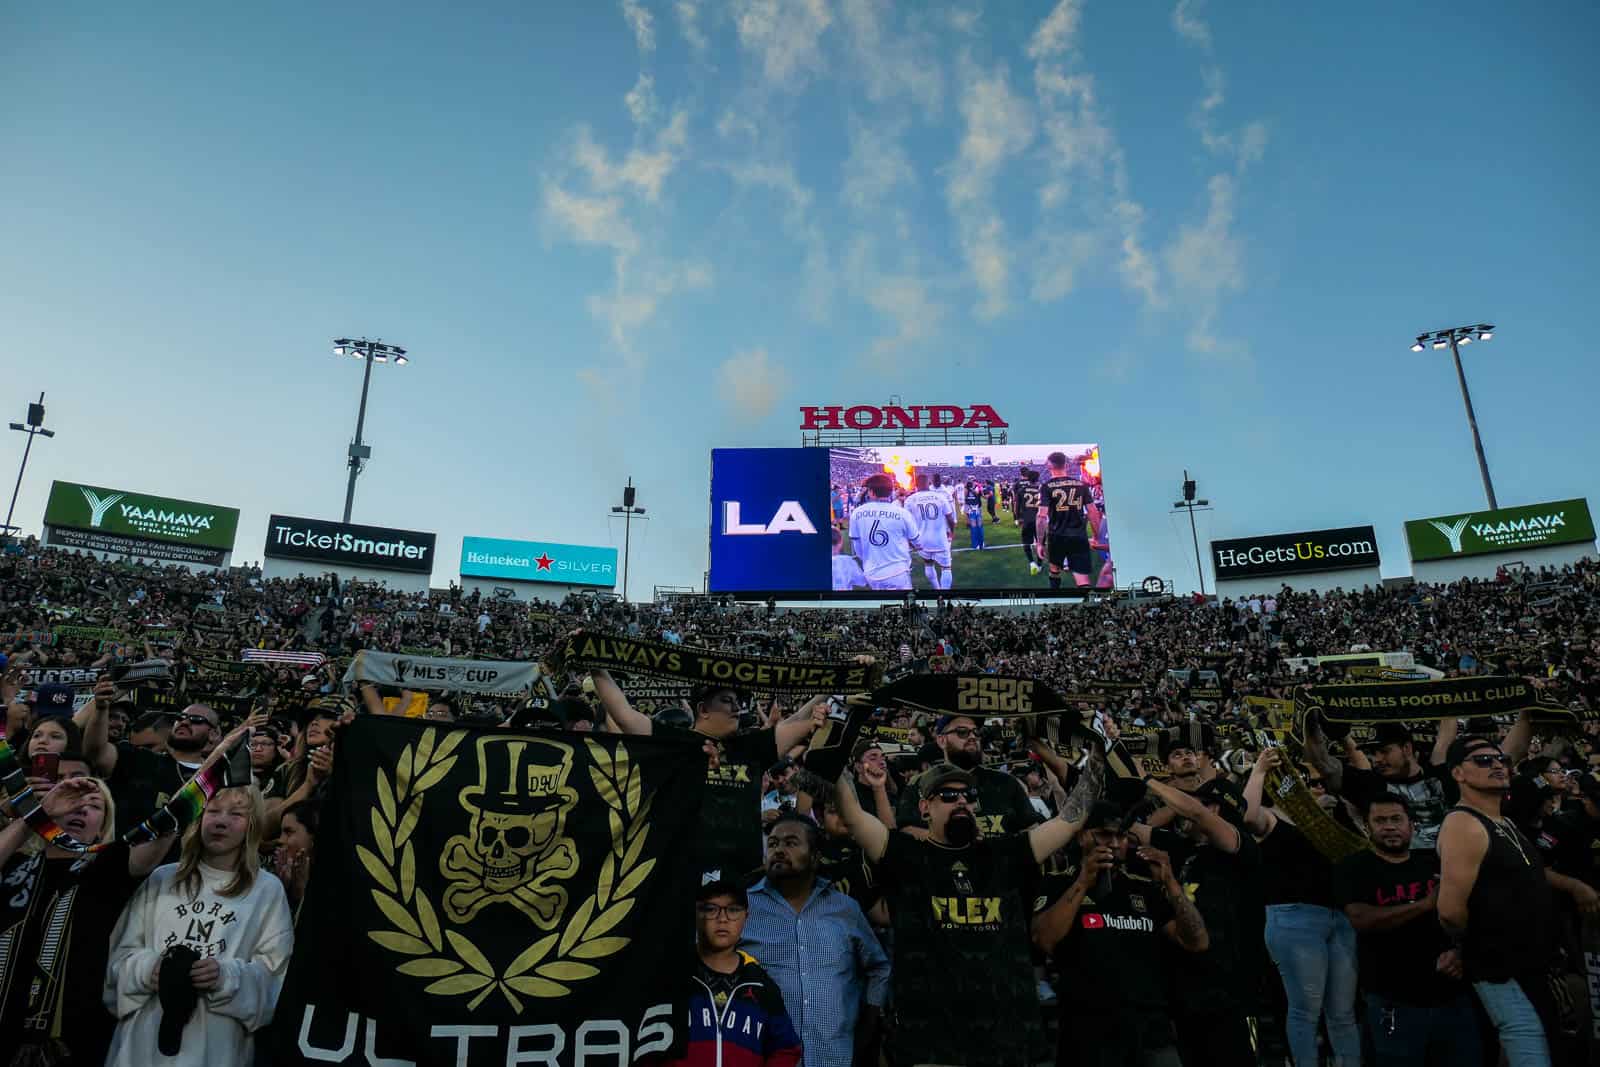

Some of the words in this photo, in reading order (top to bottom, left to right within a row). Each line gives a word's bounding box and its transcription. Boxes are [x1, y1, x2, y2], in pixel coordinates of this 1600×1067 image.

[799, 404, 1009, 430] HONDA
[1051, 487, 1084, 512] 24
[721, 500, 818, 535] LA
[879, 510, 901, 521] PUIG
[916, 502, 939, 521] 10
[55, 528, 90, 539] REPORT
[91, 533, 134, 547] INCIDENTS
[135, 539, 146, 547] OF
[128, 519, 159, 529] RESORT
[170, 525, 200, 535] CASINO
[868, 519, 889, 547] 6
[1485, 533, 1515, 542] RESORT
[1527, 528, 1557, 537] CASINO
[275, 526, 428, 560] TicketSmarter
[1216, 540, 1374, 568] HeGetsUs.com
[467, 551, 530, 567] Heineken
[557, 560, 613, 573] SILVER
[580, 638, 682, 672] ALWAYS
[413, 666, 446, 680] MLS
[466, 669, 498, 683] CUP
[622, 679, 647, 689] LOS
[648, 679, 696, 688] ANGEL
[623, 688, 679, 697] FOOTBALL
[1328, 695, 1398, 708] ANGELES
[1400, 690, 1482, 706] FOOTBALL
[1484, 685, 1527, 701] CLUB
[706, 764, 752, 783] LEX
[976, 815, 1006, 833] EX
[174, 900, 237, 925] BORN
[931, 895, 1003, 925] FLEX
[298, 1002, 675, 1067] ULTRAS
